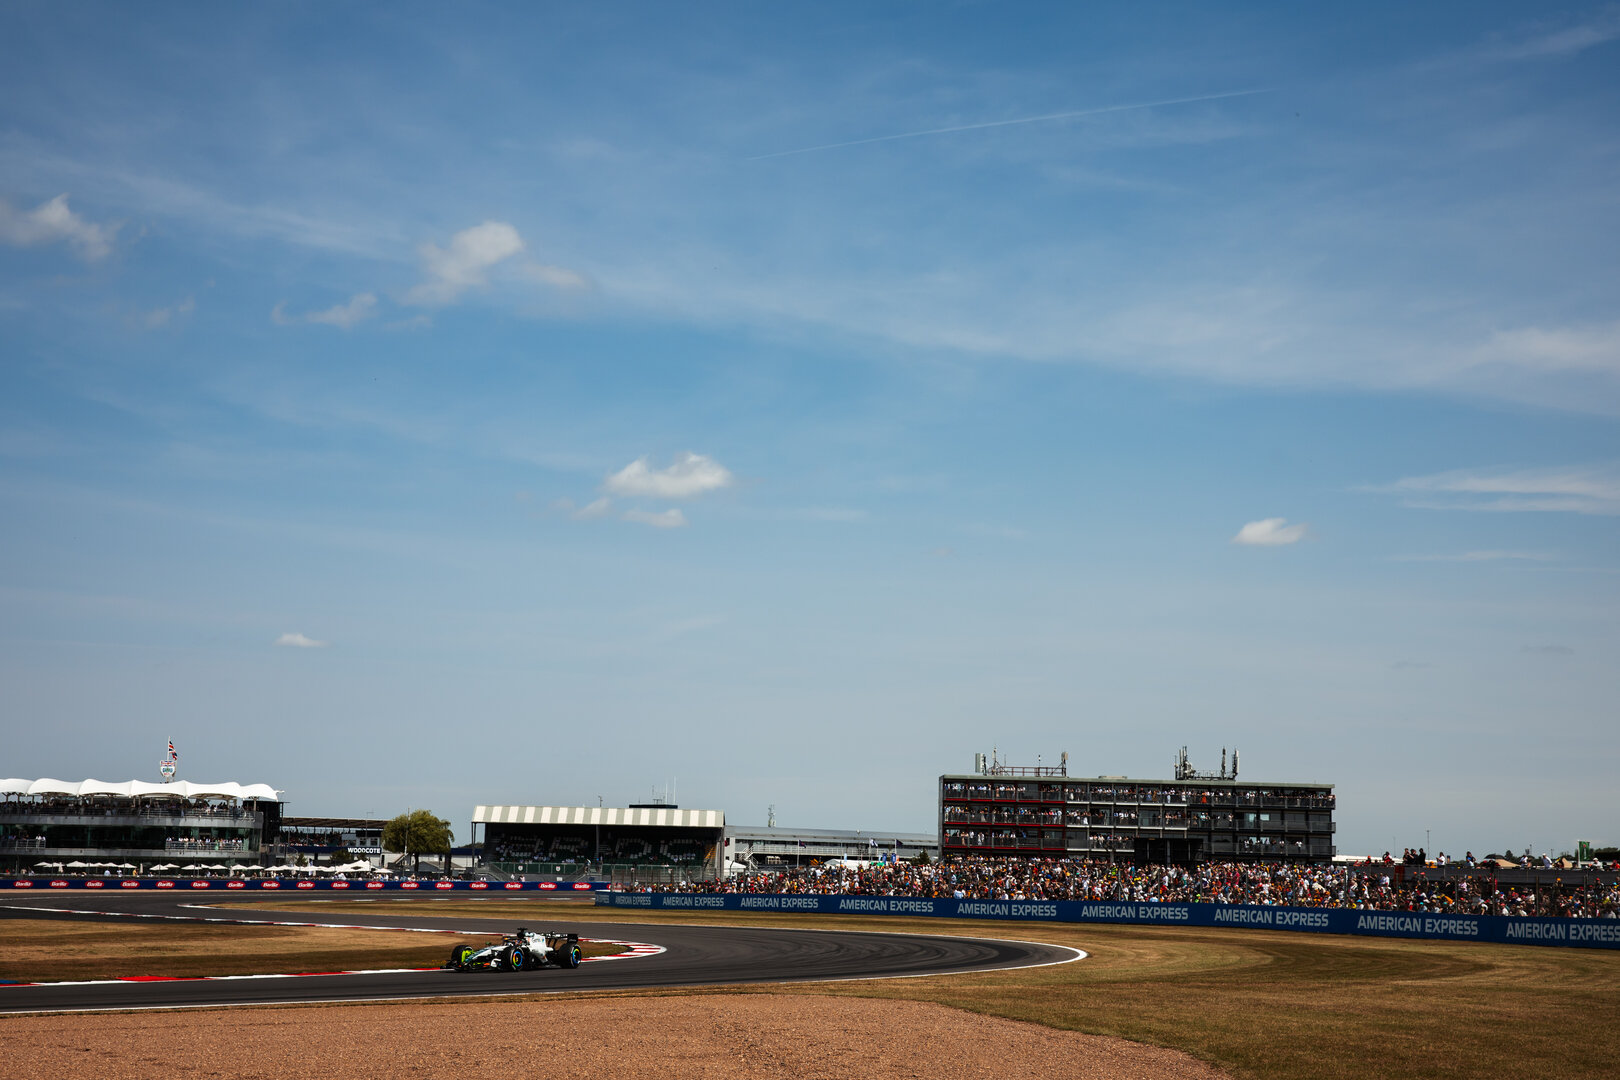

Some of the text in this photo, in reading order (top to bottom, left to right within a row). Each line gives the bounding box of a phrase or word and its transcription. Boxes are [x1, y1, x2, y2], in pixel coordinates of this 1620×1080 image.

[663, 896, 725, 907] AMERICAN EXPRESS
[740, 897, 819, 909] AMERICAN EXPRESS
[839, 899, 934, 913] AMERICAN EXPRESS
[957, 903, 1057, 917] AMERICAN EXPRESS
[1081, 905, 1189, 920] AMERICAN EXPRESS
[1214, 908, 1329, 927] AMERICAN EXPRESS
[1356, 915, 1479, 936] AMERICAN EXPRESS
[1505, 922, 1620, 942] AMERICAN EXPRESS
